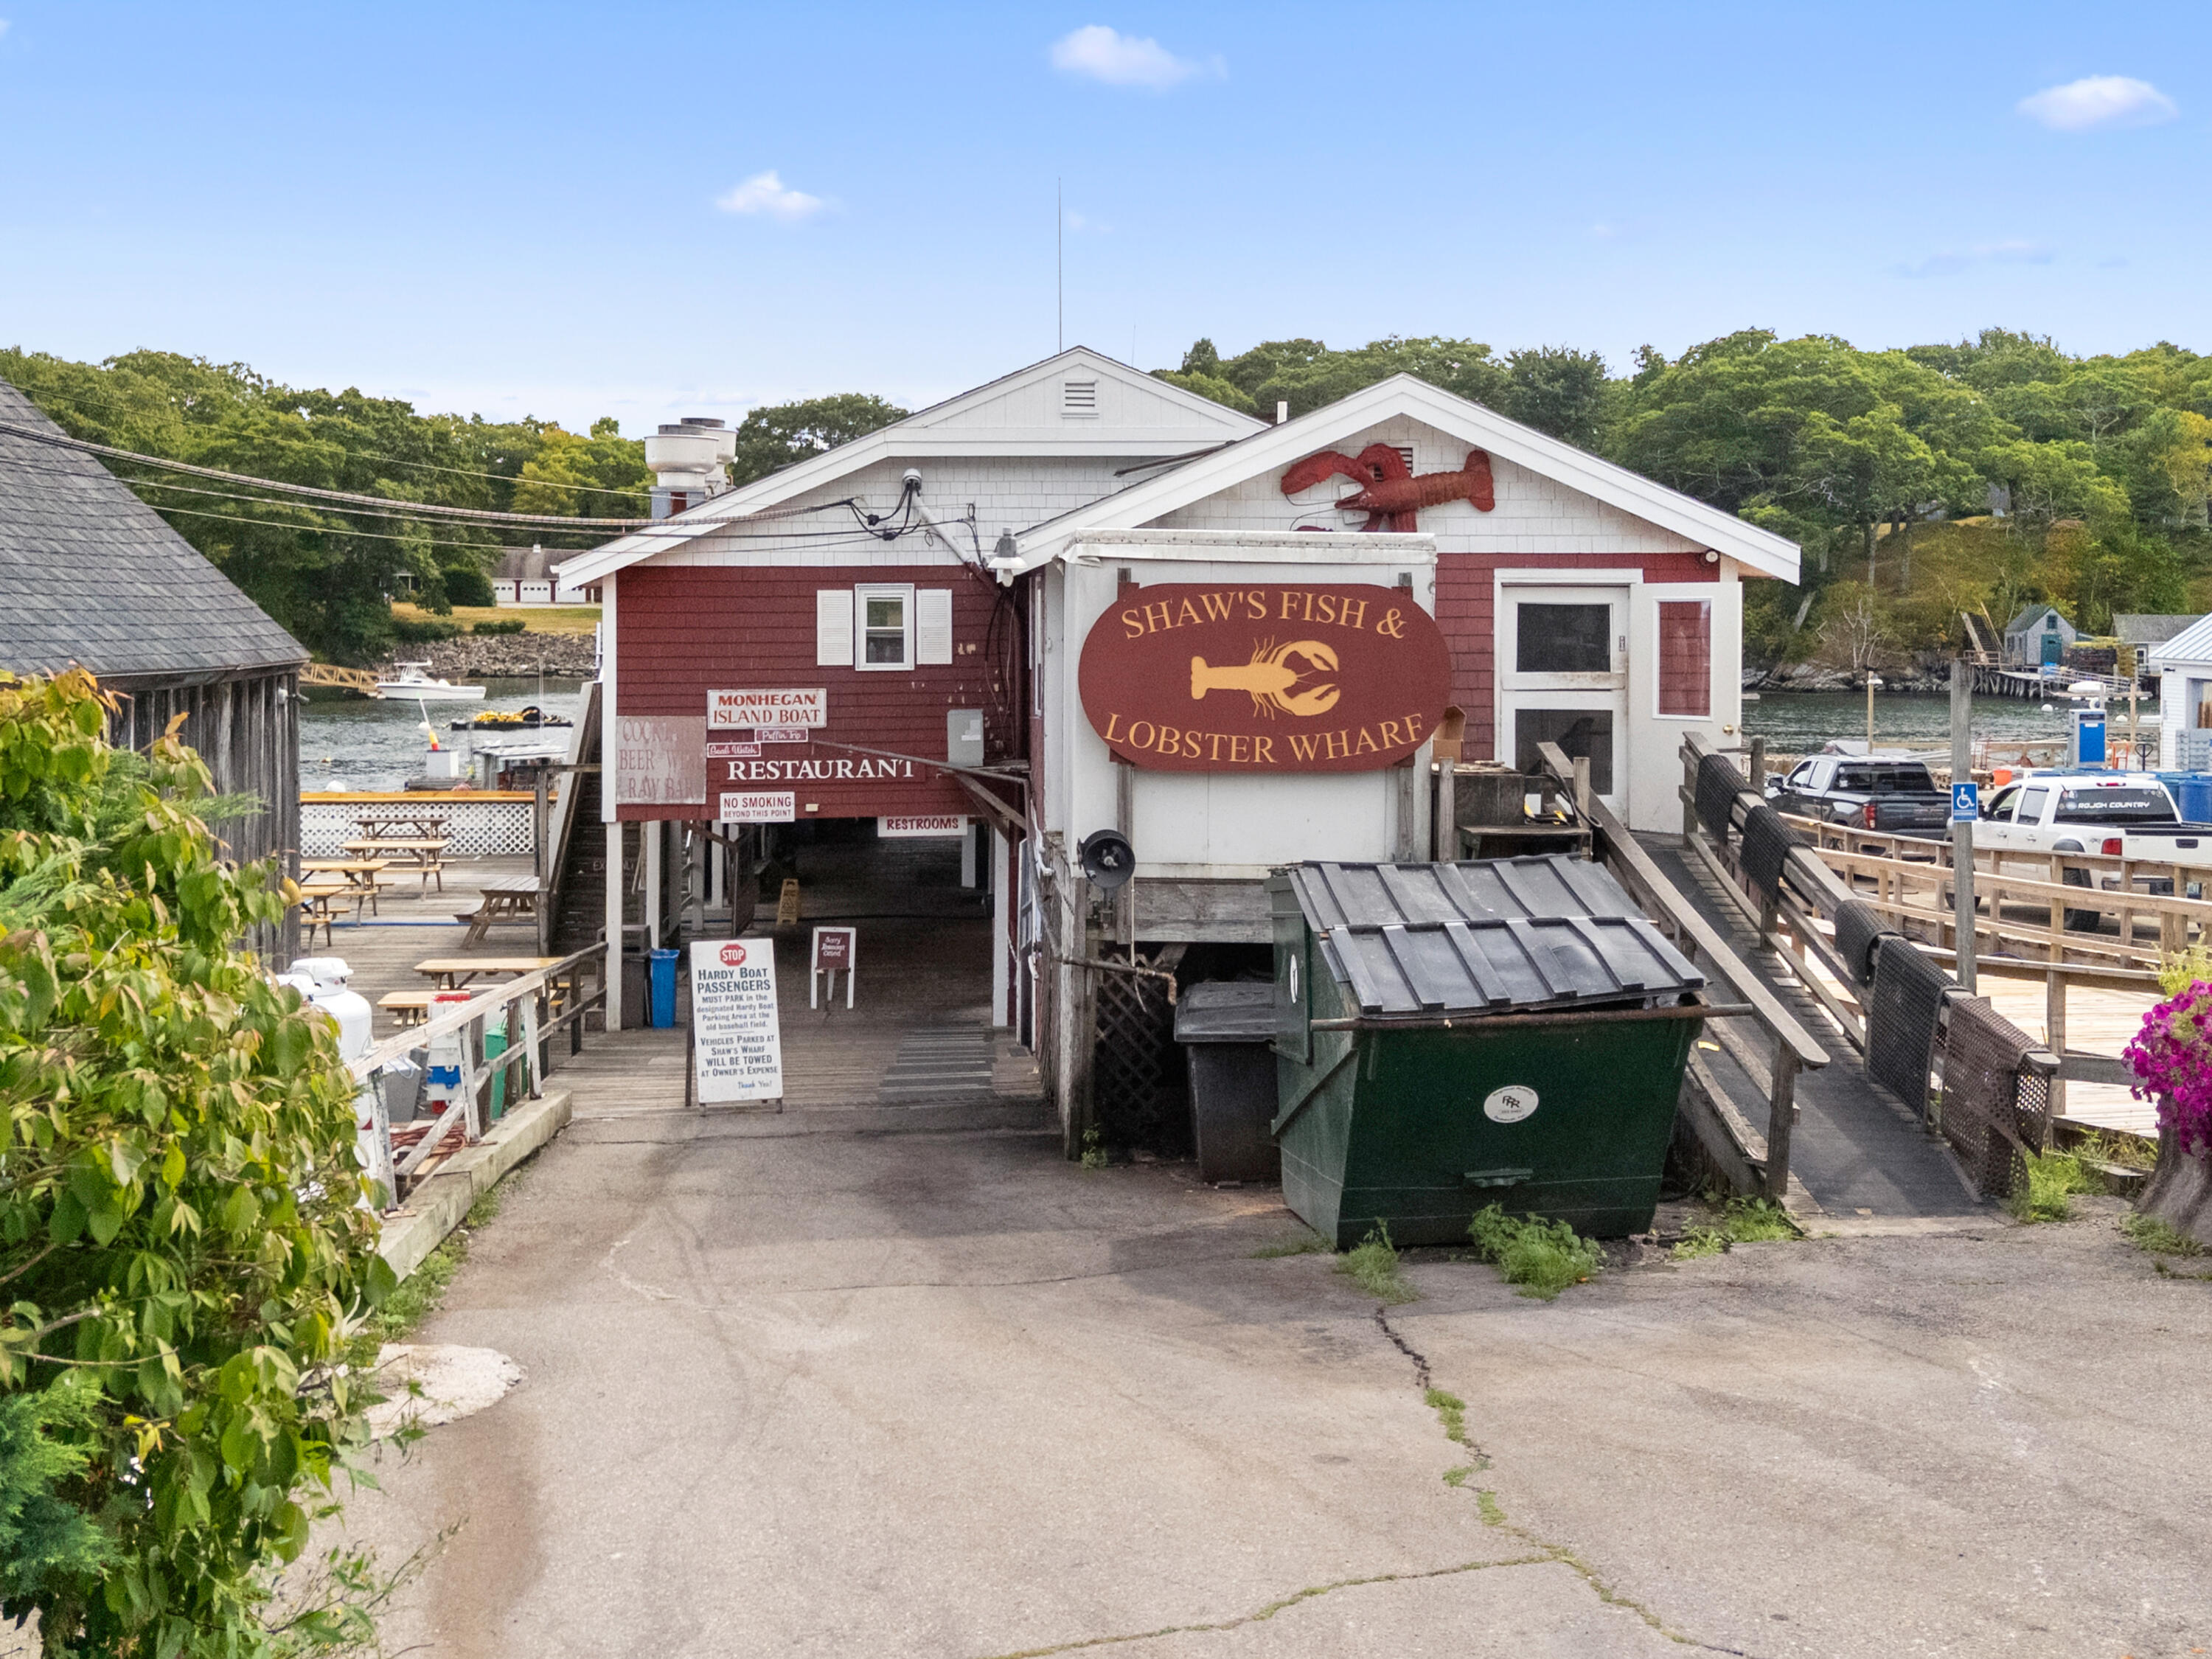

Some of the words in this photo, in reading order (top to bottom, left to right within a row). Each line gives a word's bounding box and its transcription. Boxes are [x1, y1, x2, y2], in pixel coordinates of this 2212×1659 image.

[1121, 591, 1266, 639] SHAW'S
[1280, 591, 1369, 629] FISH
[1375, 608, 1407, 639] &
[717, 694, 817, 706] MONHEGAN
[713, 710, 772, 723] ISLAND
[779, 709, 821, 723] BOAT
[787, 730, 801, 741] Trip
[1105, 713, 1277, 764] LOBSTER
[1289, 713, 1424, 762] WHARF
[619, 749, 654, 770] BEER
[727, 759, 914, 780] RESTAURANT
[628, 777, 660, 799] RAW
[723, 797, 738, 808] NO
[742, 796, 792, 808] SMOKING
[886, 818, 959, 830] RESTROOMS
[722, 949, 744, 961] STOP
[698, 969, 734, 981] HARDY
[740, 967, 768, 978] BOAT
[697, 979, 771, 994] PASSENGERS
[702, 995, 723, 1004] MUST
[702, 1014, 730, 1022] Parking
[700, 1037, 734, 1046] VEHICLES
[711, 1047, 738, 1056] SHAW'S
[706, 1057, 727, 1067] WILL
[729, 1057, 740, 1065] BE
[743, 1055, 772, 1065] TOWED
